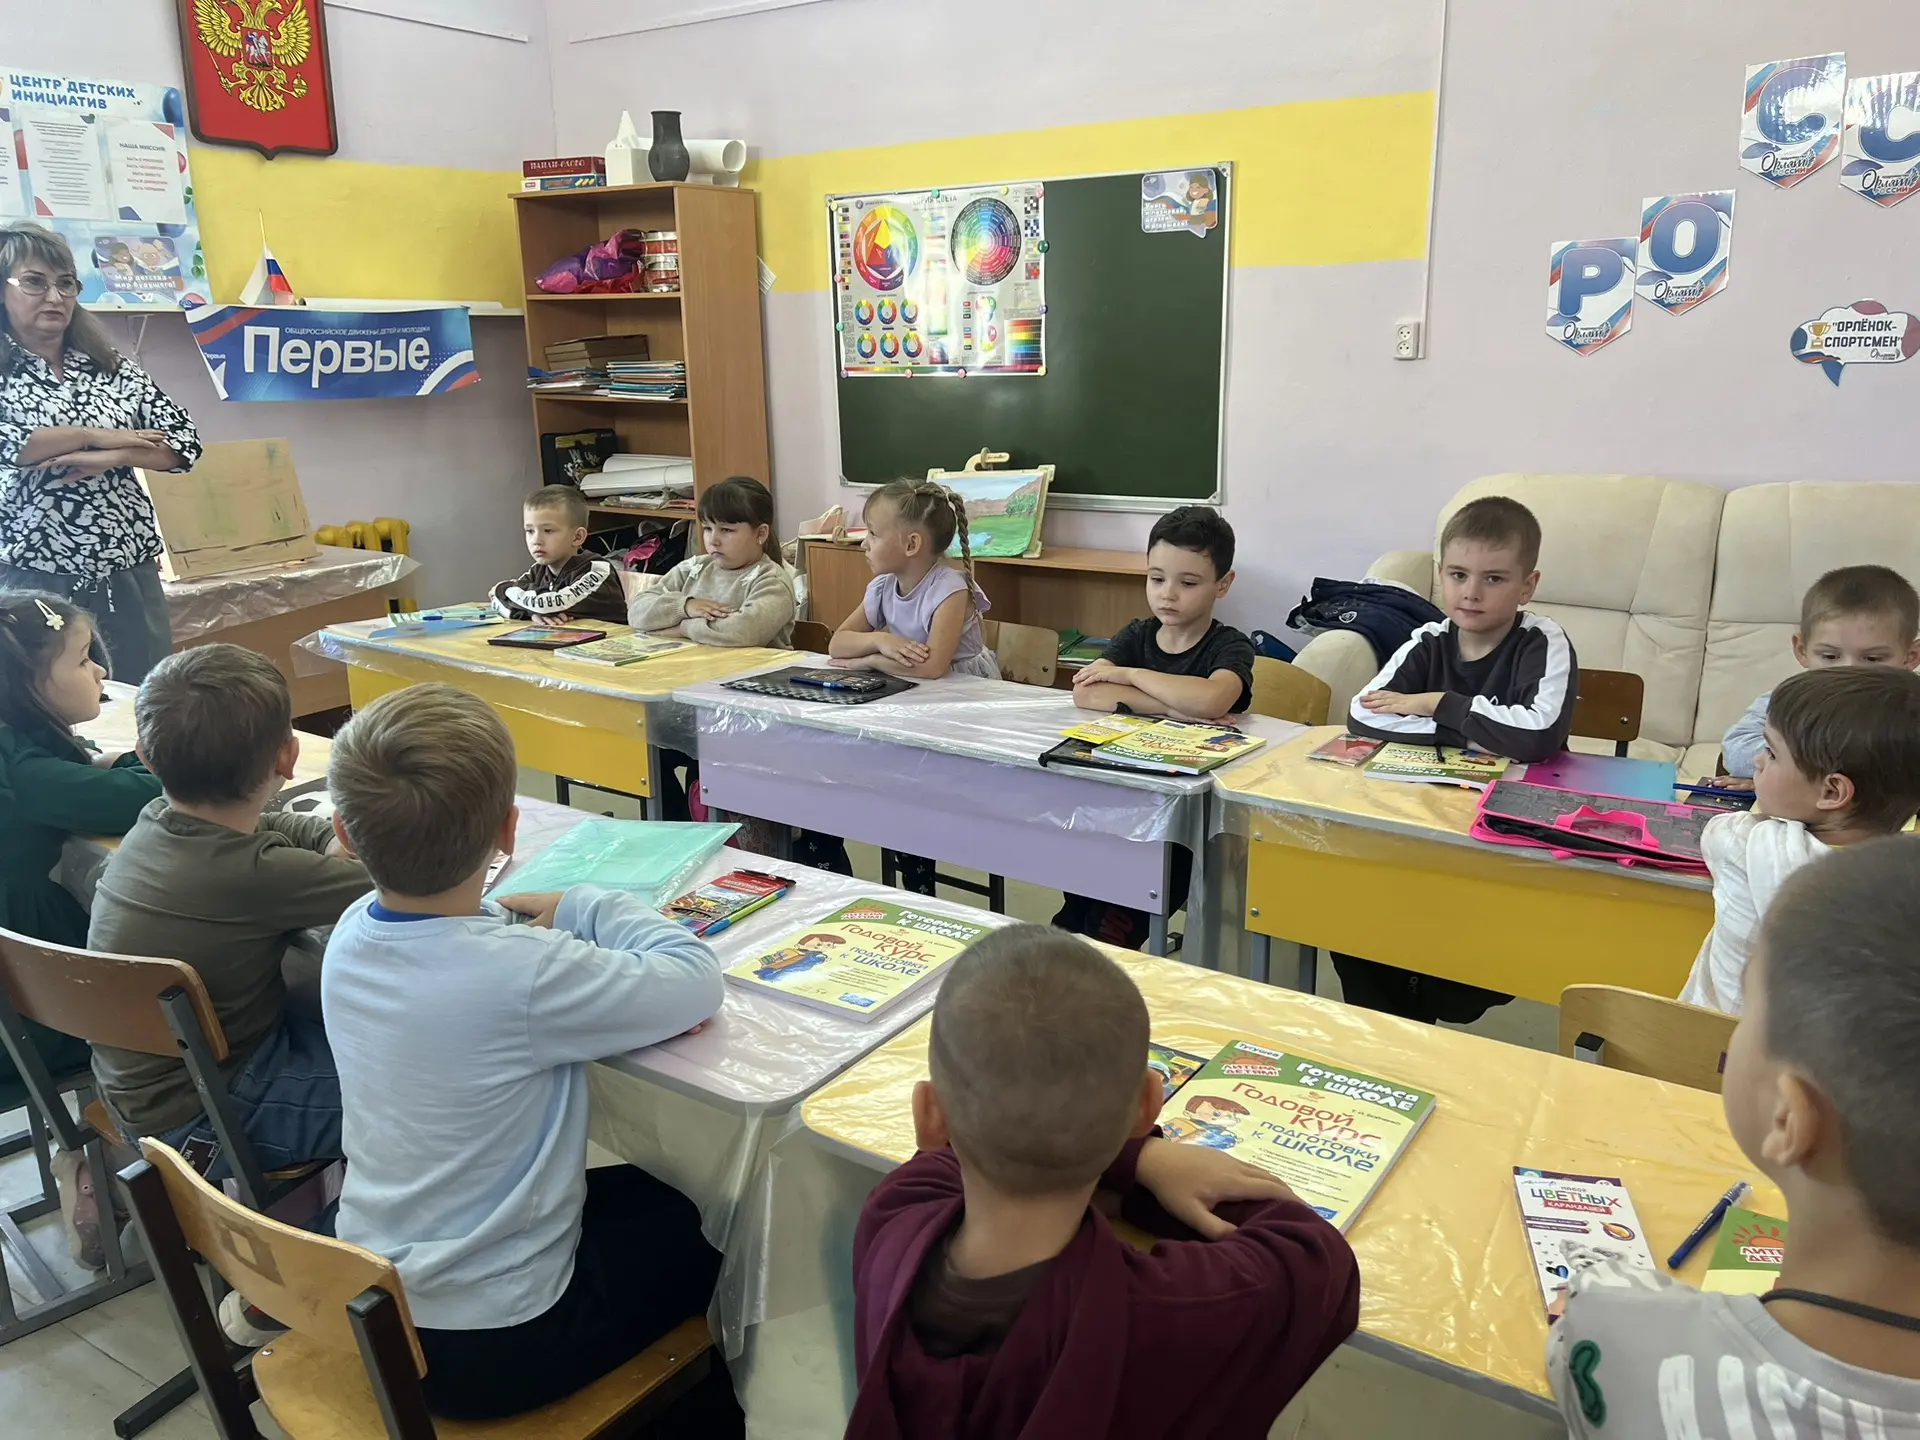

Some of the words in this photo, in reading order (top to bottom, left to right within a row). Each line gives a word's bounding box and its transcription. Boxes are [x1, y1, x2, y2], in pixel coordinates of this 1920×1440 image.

[9, 73, 62, 90] ЦЕНТР
[67, 80, 136, 99] ДЕТСКИХ
[11, 89, 108, 110] ИНИЦИАТИВ
[1649, 199, 1722, 276] О
[1557, 246, 1625, 318] Р
[284, 326, 347, 336] ОБЩЕРОССИЙСКОЕ
[380, 327, 396, 335] ДЕТЕЙ
[243, 325, 430, 389] Первые
[913, 921, 974, 941] ШКОЛЕ
[1323, 1082, 1414, 1112] ШКОЛЕ
[1530, 1188, 1622, 1208] ЦВЕТНЫХ
